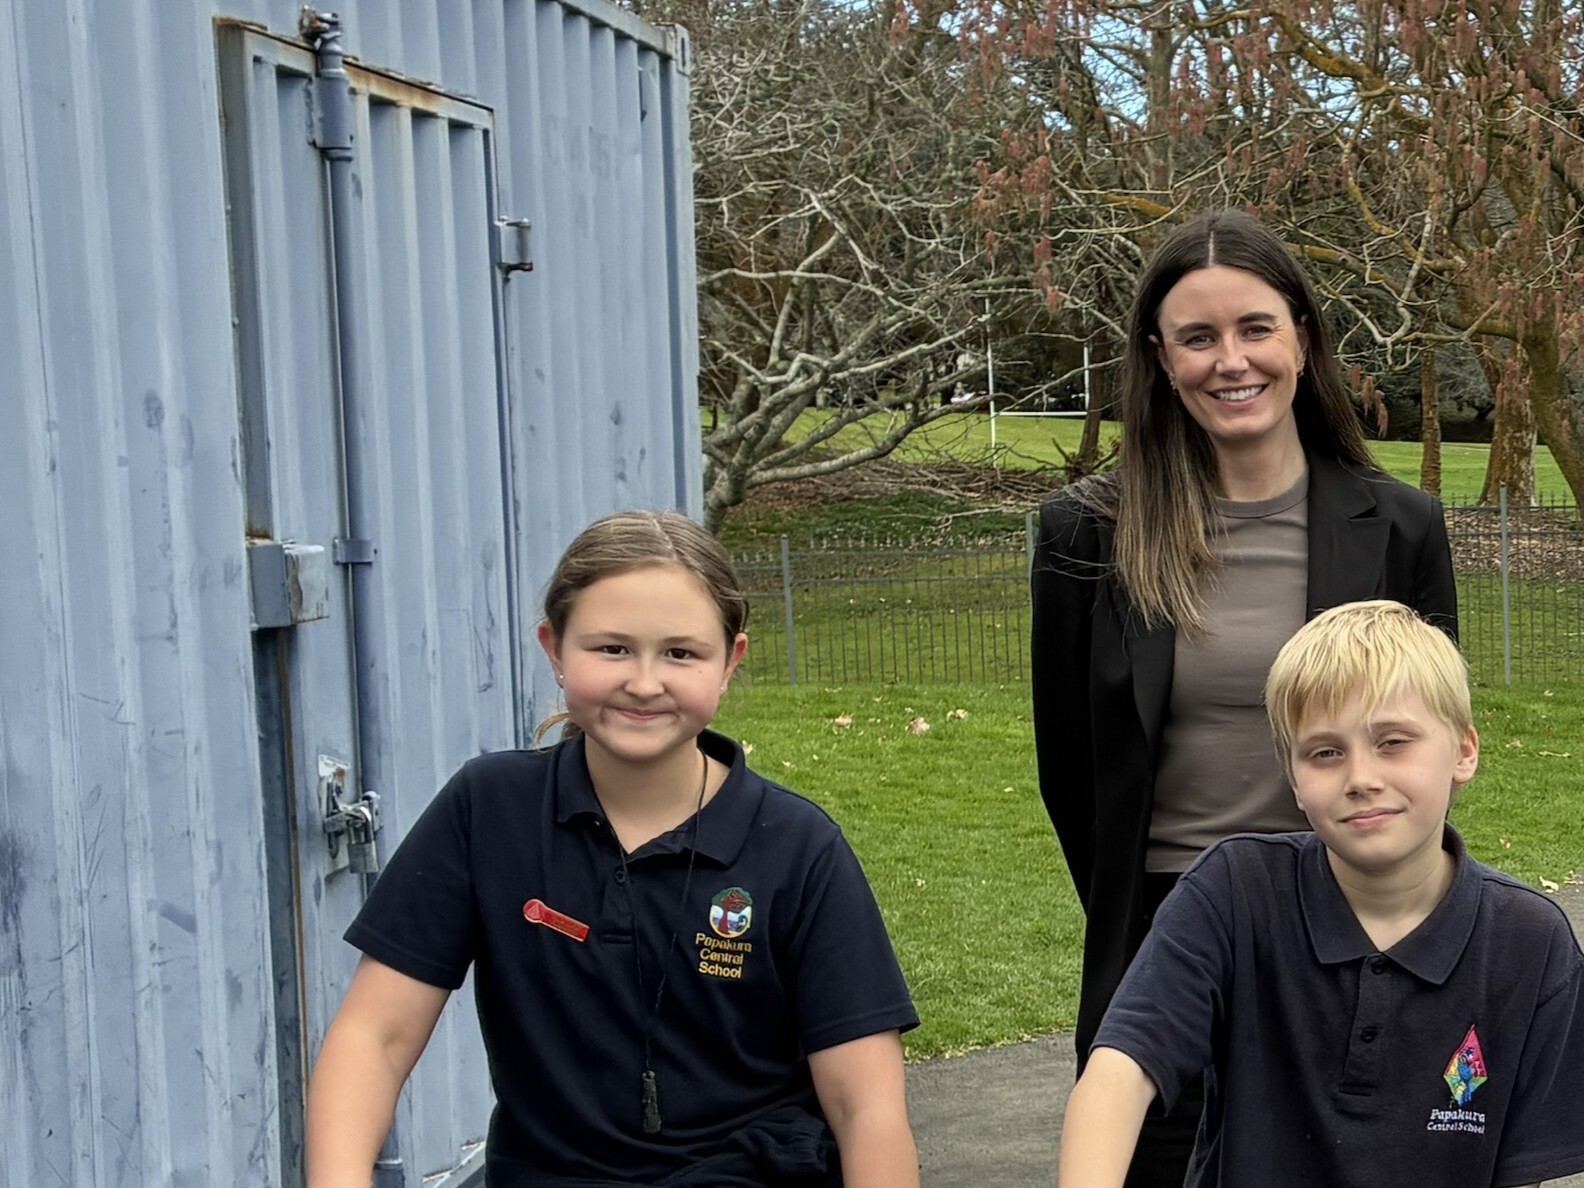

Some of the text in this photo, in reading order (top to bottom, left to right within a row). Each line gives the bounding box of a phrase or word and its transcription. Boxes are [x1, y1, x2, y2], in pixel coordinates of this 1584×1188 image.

[696, 933, 752, 952] Papakura
[700, 948, 744, 965] Central
[699, 961, 742, 979] School
[1430, 1108, 1486, 1123] Papakura
